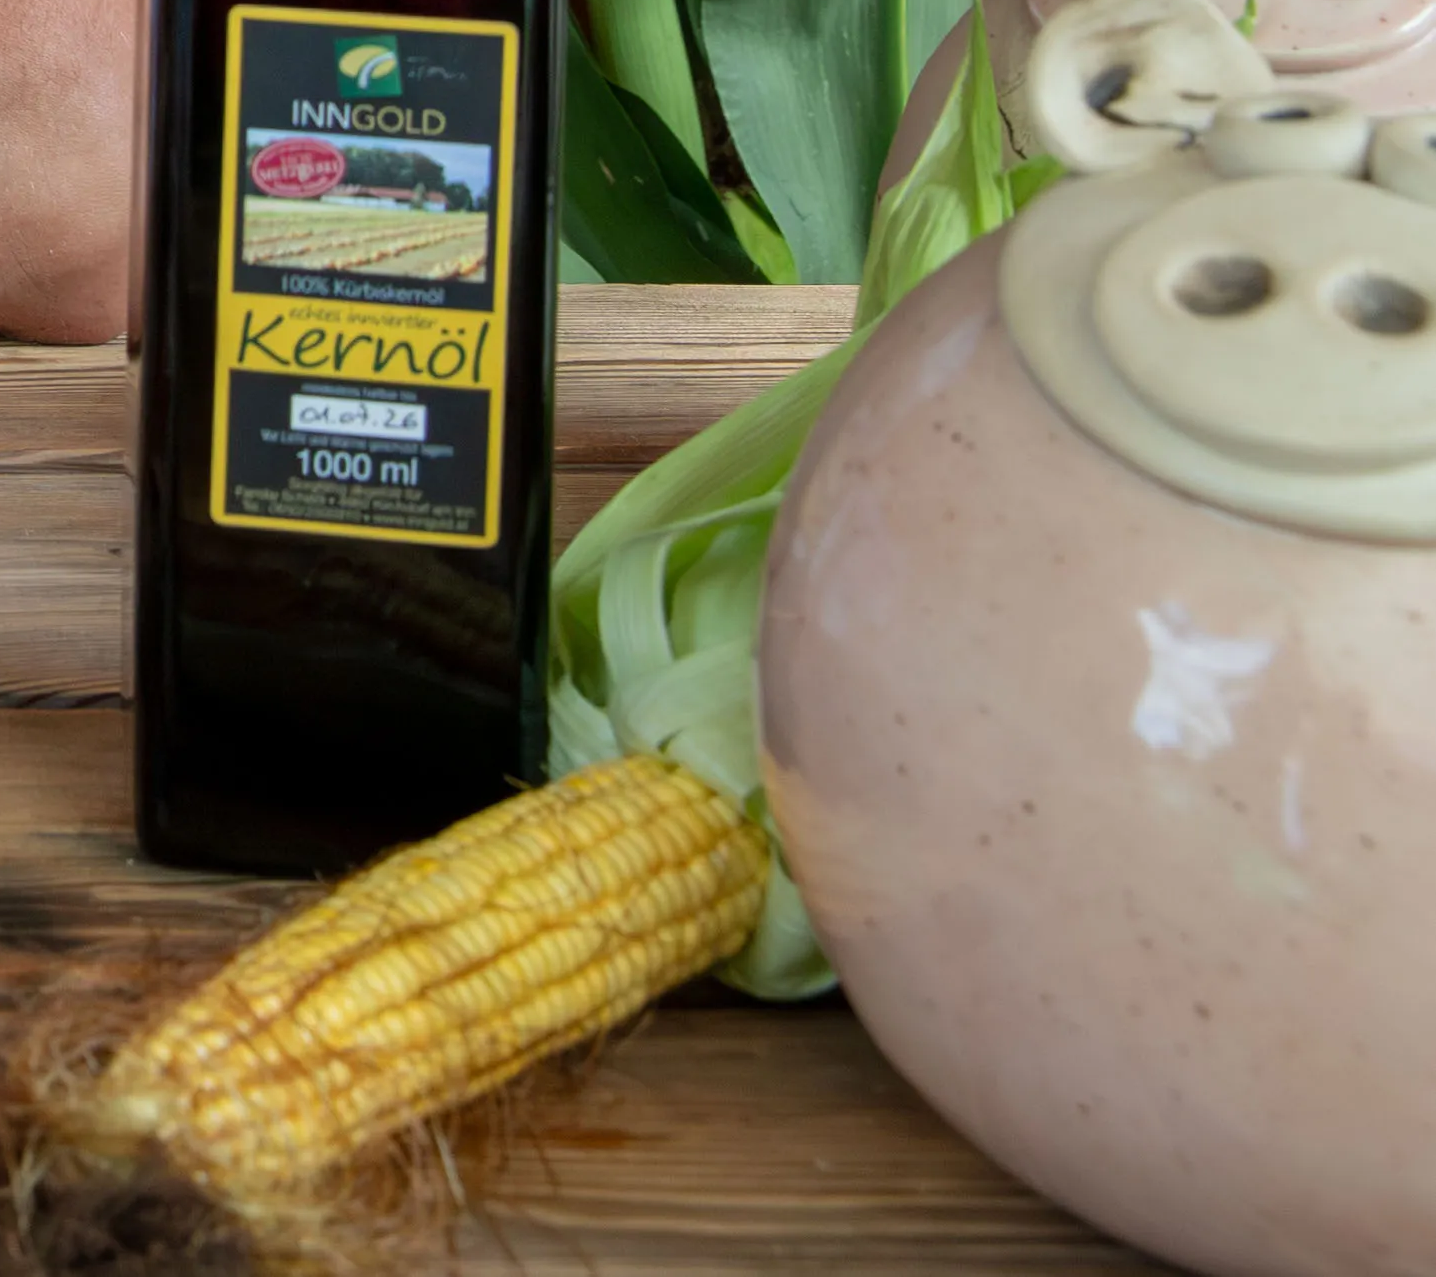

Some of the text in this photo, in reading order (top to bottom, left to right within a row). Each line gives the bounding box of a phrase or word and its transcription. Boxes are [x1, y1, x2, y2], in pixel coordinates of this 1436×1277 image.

[292, 99, 446, 136] INNGOLD
[281, 274, 328, 296] 100%
[237, 309, 490, 383] Kernöl
[295, 448, 418, 486] 1000 ml
